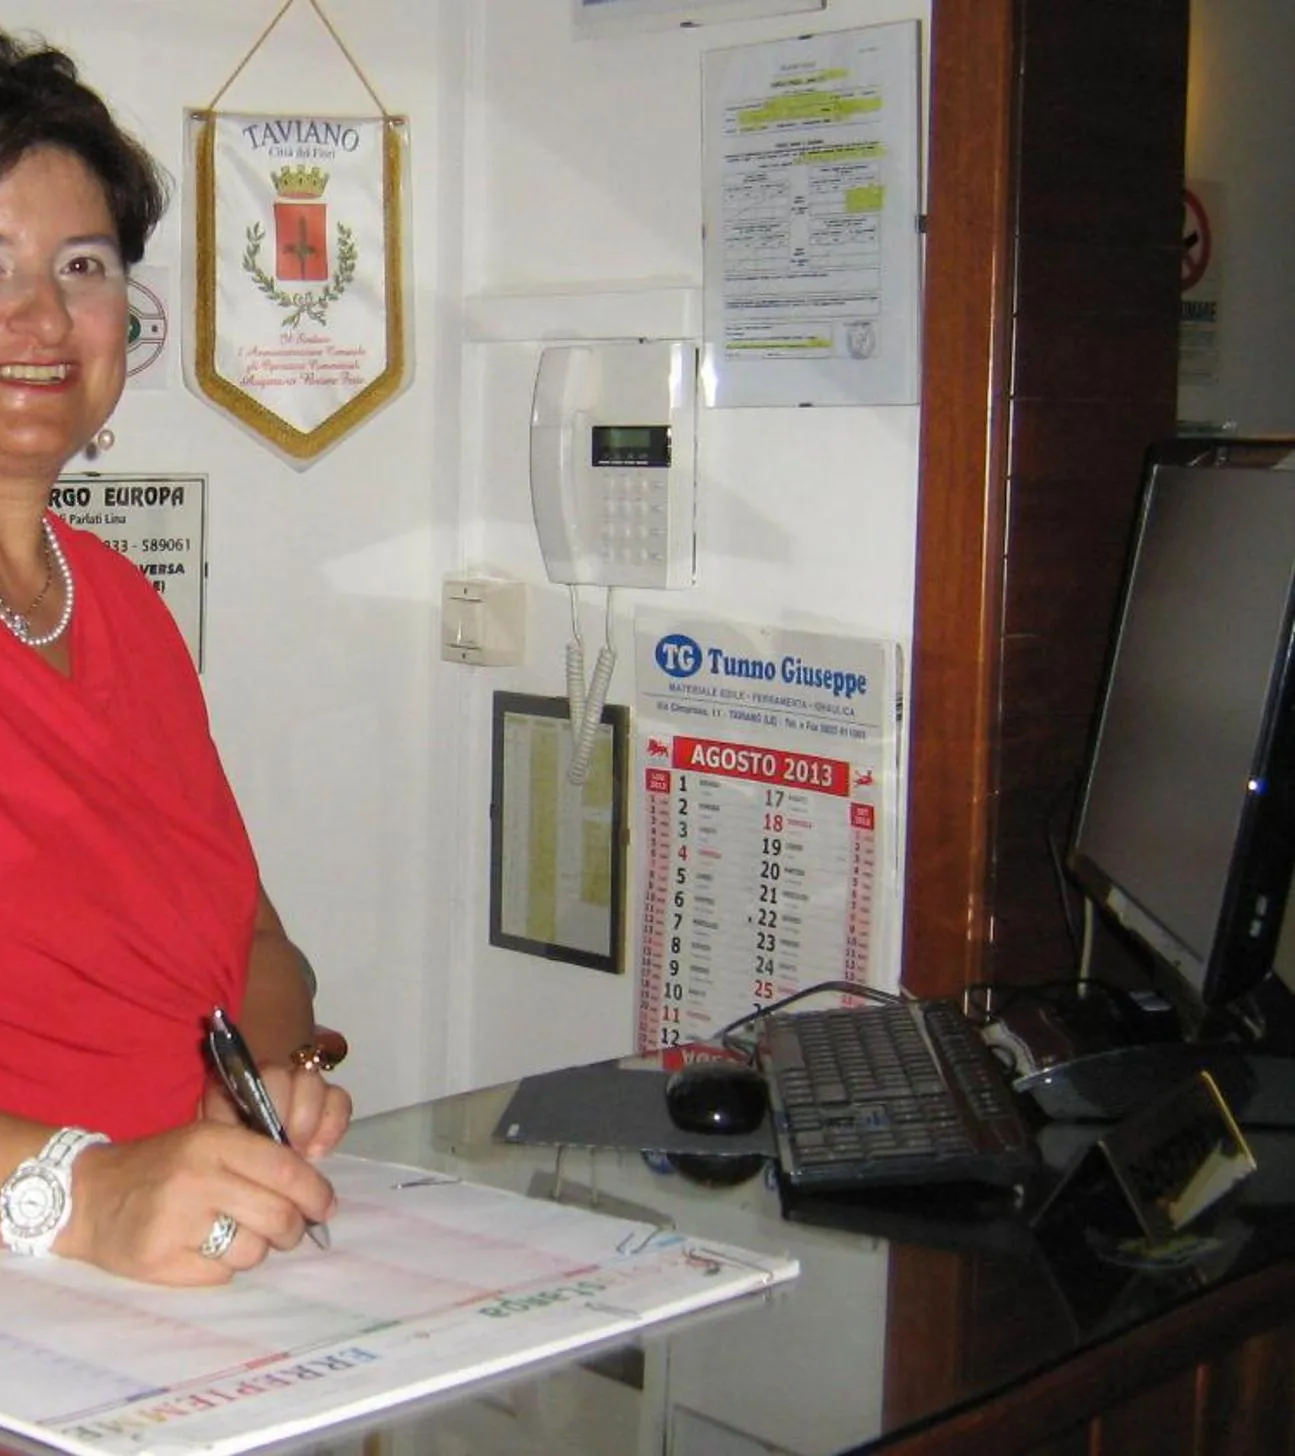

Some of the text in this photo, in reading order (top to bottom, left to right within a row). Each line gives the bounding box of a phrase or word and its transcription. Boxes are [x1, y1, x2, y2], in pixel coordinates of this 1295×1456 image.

[242, 119, 360, 152] TAVIANO
[104, 487, 185, 508] EUROPA
[105, 514, 127, 525] Lina
[142, 537, 191, 552] 589061
[707, 648, 776, 681] Tunno
[780, 655, 868, 699] Giuseppe
[690, 743, 833, 787] AGOSTO 2013
[678, 776, 687, 792] 1
[678, 799, 688, 815] 2
[766, 789, 784, 808] 17
[678, 821, 688, 837] 3
[764, 813, 783, 832] 18
[678, 845, 687, 861] 4
[762, 838, 781, 856] 19
[676, 868, 686, 884] 5
[760, 861, 780, 880] 20
[674, 891, 684, 907] 6
[759, 884, 777, 904] 21
[673, 913, 683, 930] 7
[758, 908, 777, 928] 22
[671, 937, 681, 953] 8
[757, 932, 775, 952] 23
[669, 960, 679, 976] 9
[755, 955, 774, 976] 24
[664, 982, 683, 1000] 10
[754, 979, 773, 999] 25
[663, 1005, 680, 1023] 11
[661, 1028, 680, 1046] 12
